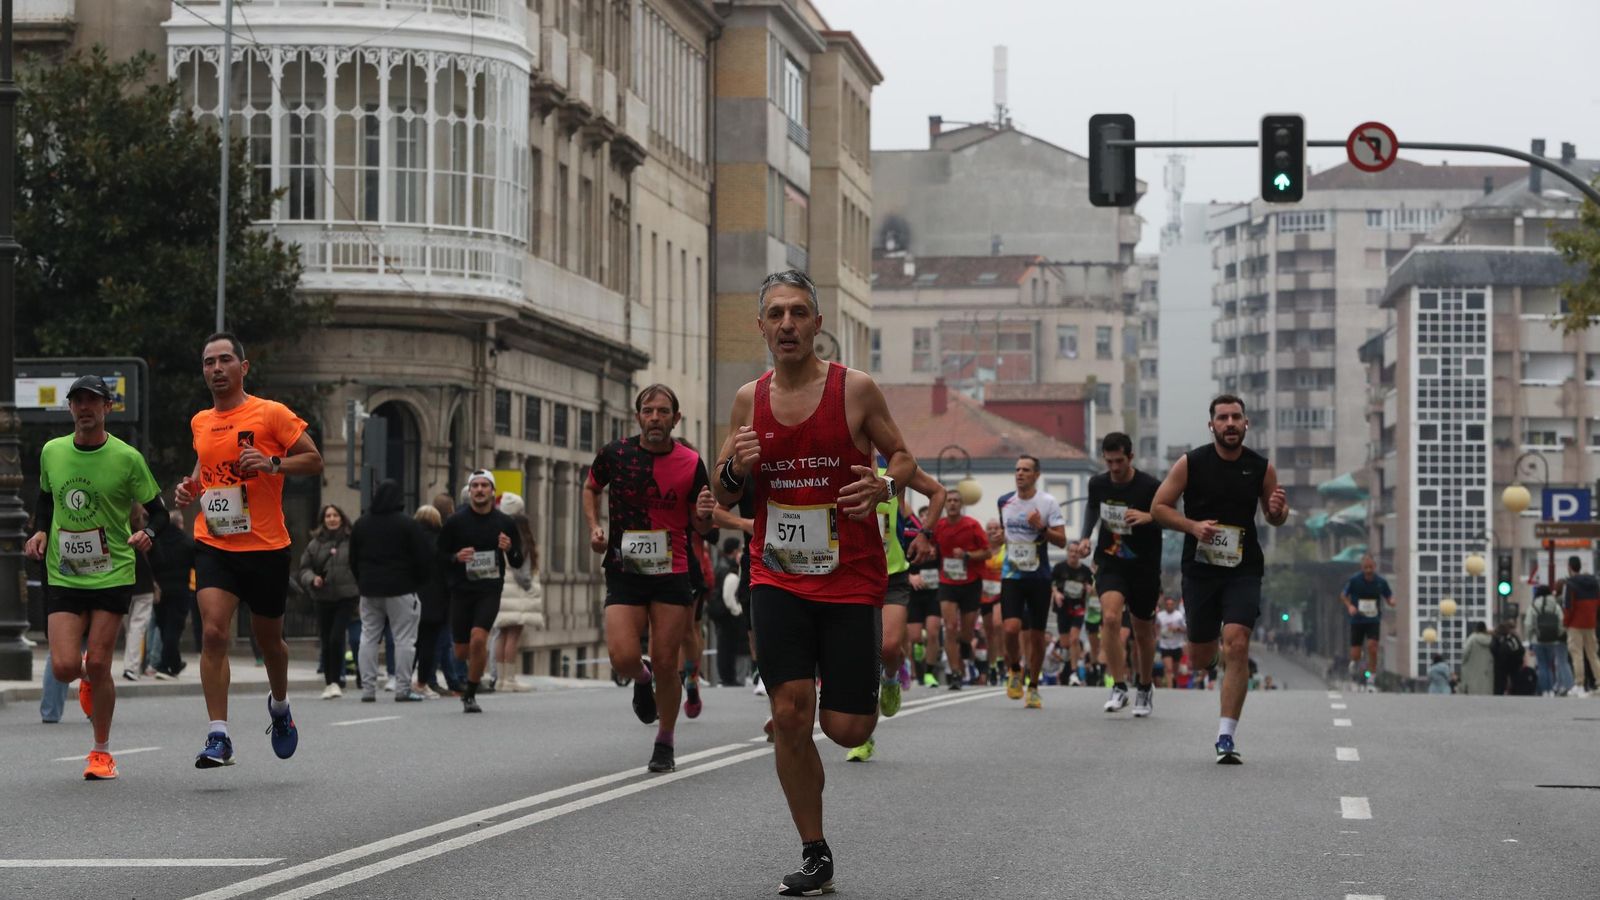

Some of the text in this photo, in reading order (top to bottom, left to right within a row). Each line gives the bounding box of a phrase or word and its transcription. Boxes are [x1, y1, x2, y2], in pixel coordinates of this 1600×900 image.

[760, 456, 840, 472] ALEX TEAM
[207, 498, 230, 513] 452
[1552, 493, 1579, 523] P
[777, 522, 806, 543] 571
[64, 540, 93, 555] 9655
[629, 541, 658, 554] 2731
